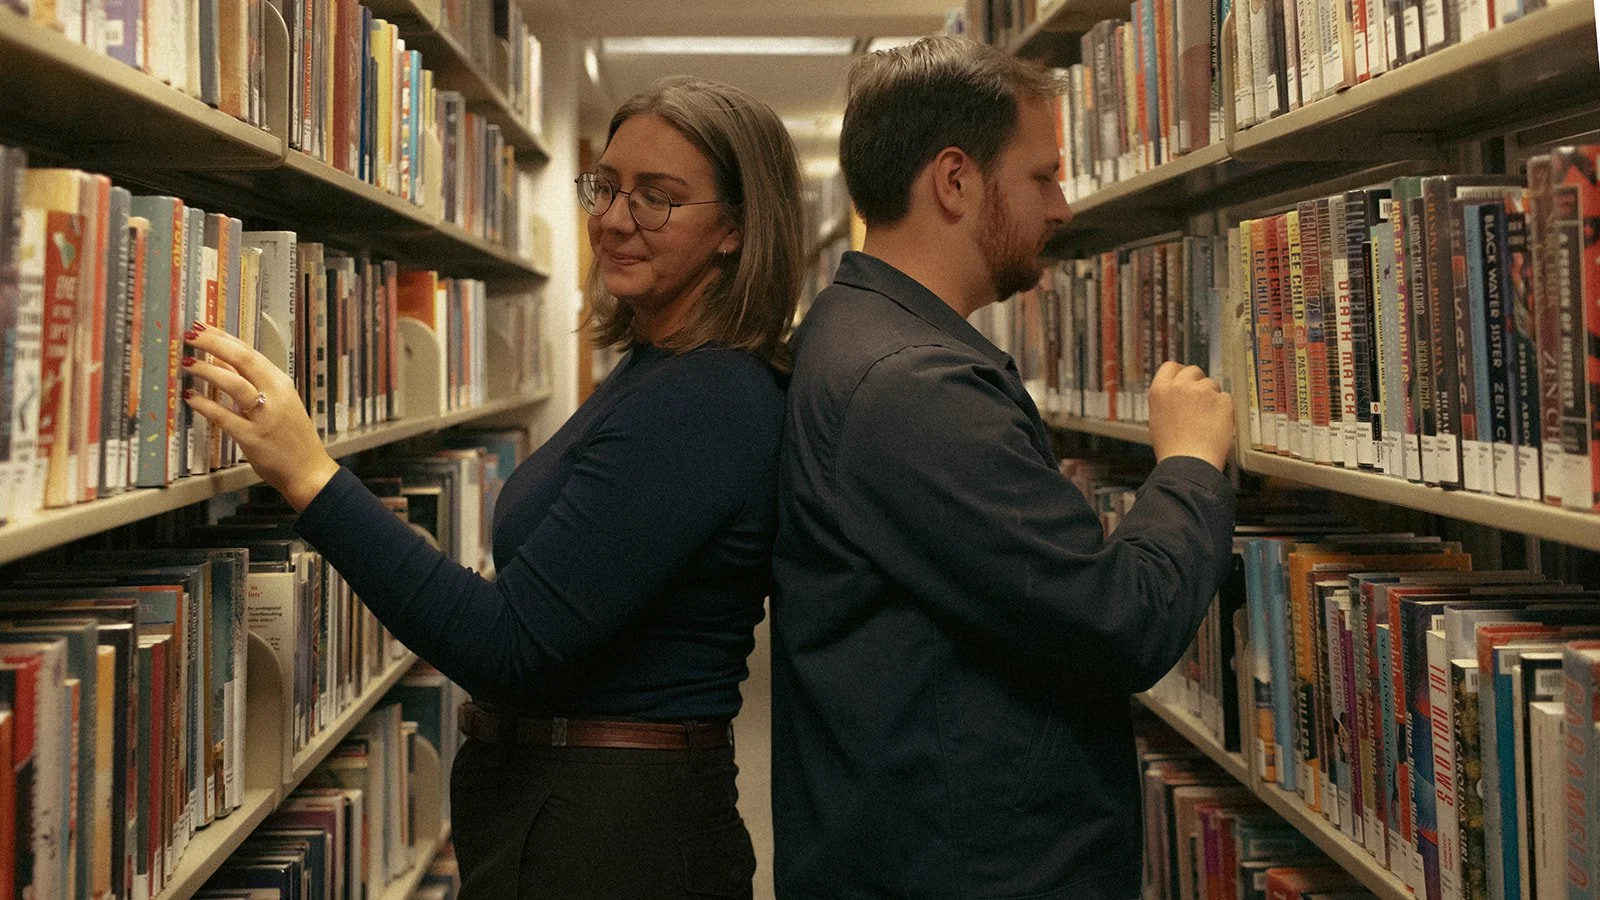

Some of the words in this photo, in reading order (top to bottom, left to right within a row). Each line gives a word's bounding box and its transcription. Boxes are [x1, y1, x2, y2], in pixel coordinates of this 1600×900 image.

[1301, 31, 1309, 65] MARC
[1299, 207, 1318, 268] TERMINAL
[1392, 200, 1402, 232] KING
[1410, 214, 1421, 254] GWENDY'S
[1427, 192, 1438, 257] CHASING
[173, 220, 182, 267] FORD
[1281, 247, 1290, 271] LEE
[1291, 242, 1302, 270] LEE
[1345, 200, 1365, 279] LINCOLN
[1394, 238, 1403, 258] OF
[1484, 214, 1497, 264] BLACK
[1560, 233, 1569, 243] A
[288, 242, 297, 315] HEARTWOOD
[1255, 250, 1266, 273] LEE
[1267, 247, 1280, 274] LEE
[1395, 260, 1404, 286] THE
[1412, 256, 1423, 281] MAGIC
[1560, 249, 1571, 309] PERSON
[1256, 277, 1269, 316] CHILD
[1269, 277, 1282, 321] CHILD
[1283, 275, 1293, 315] CHILD
[1292, 274, 1304, 320] CHILD
[1303, 274, 1321, 313] FREEZE
[1339, 280, 1351, 341] DEATH
[1414, 283, 1425, 315] FEATHER
[1487, 268, 1501, 318] WATER
[1396, 293, 1409, 382] ARMADILLOS
[1562, 313, 1572, 331] OF
[1417, 340, 1428, 373] RICHARD
[1454, 297, 1468, 405] SAHA
[1489, 323, 1503, 368] SISTER
[1260, 359, 1275, 412] AFFAIR
[1297, 356, 1306, 384] PAST
[1342, 351, 1356, 415] MATCH
[1518, 342, 1528, 397] SPIRITS
[1543, 350, 1558, 398] ZEN
[1563, 336, 1575, 409] INTEREST
[1298, 386, 1309, 417] TENSE
[1418, 376, 1430, 410] CHIZMAR
[1441, 391, 1450, 433] RICHA
[1493, 382, 1505, 419] ZEN
[1521, 401, 1530, 447] ABROA
[1546, 407, 1560, 443] CH
[1293, 602, 1305, 676] COMPANY
[1330, 610, 1339, 633] THE
[1359, 594, 1371, 674] DAUGHTERS
[1331, 638, 1343, 707] COMEBACK
[1365, 679, 1372, 696] OF
[1382, 663, 1391, 716] CHANGE
[1430, 664, 1447, 696] THE
[1298, 691, 1309, 758] KILLERS
[1366, 700, 1378, 775] SHANDONG
[1405, 711, 1414, 754] Silver
[1453, 697, 1462, 737] LAST
[1407, 756, 1415, 799] Under
[1432, 704, 1454, 808] HOLLOWS
[1455, 740, 1466, 822] CAROLINA
[1564, 678, 1590, 890] CARAMELO
[1460, 829, 1468, 863] GIRL
